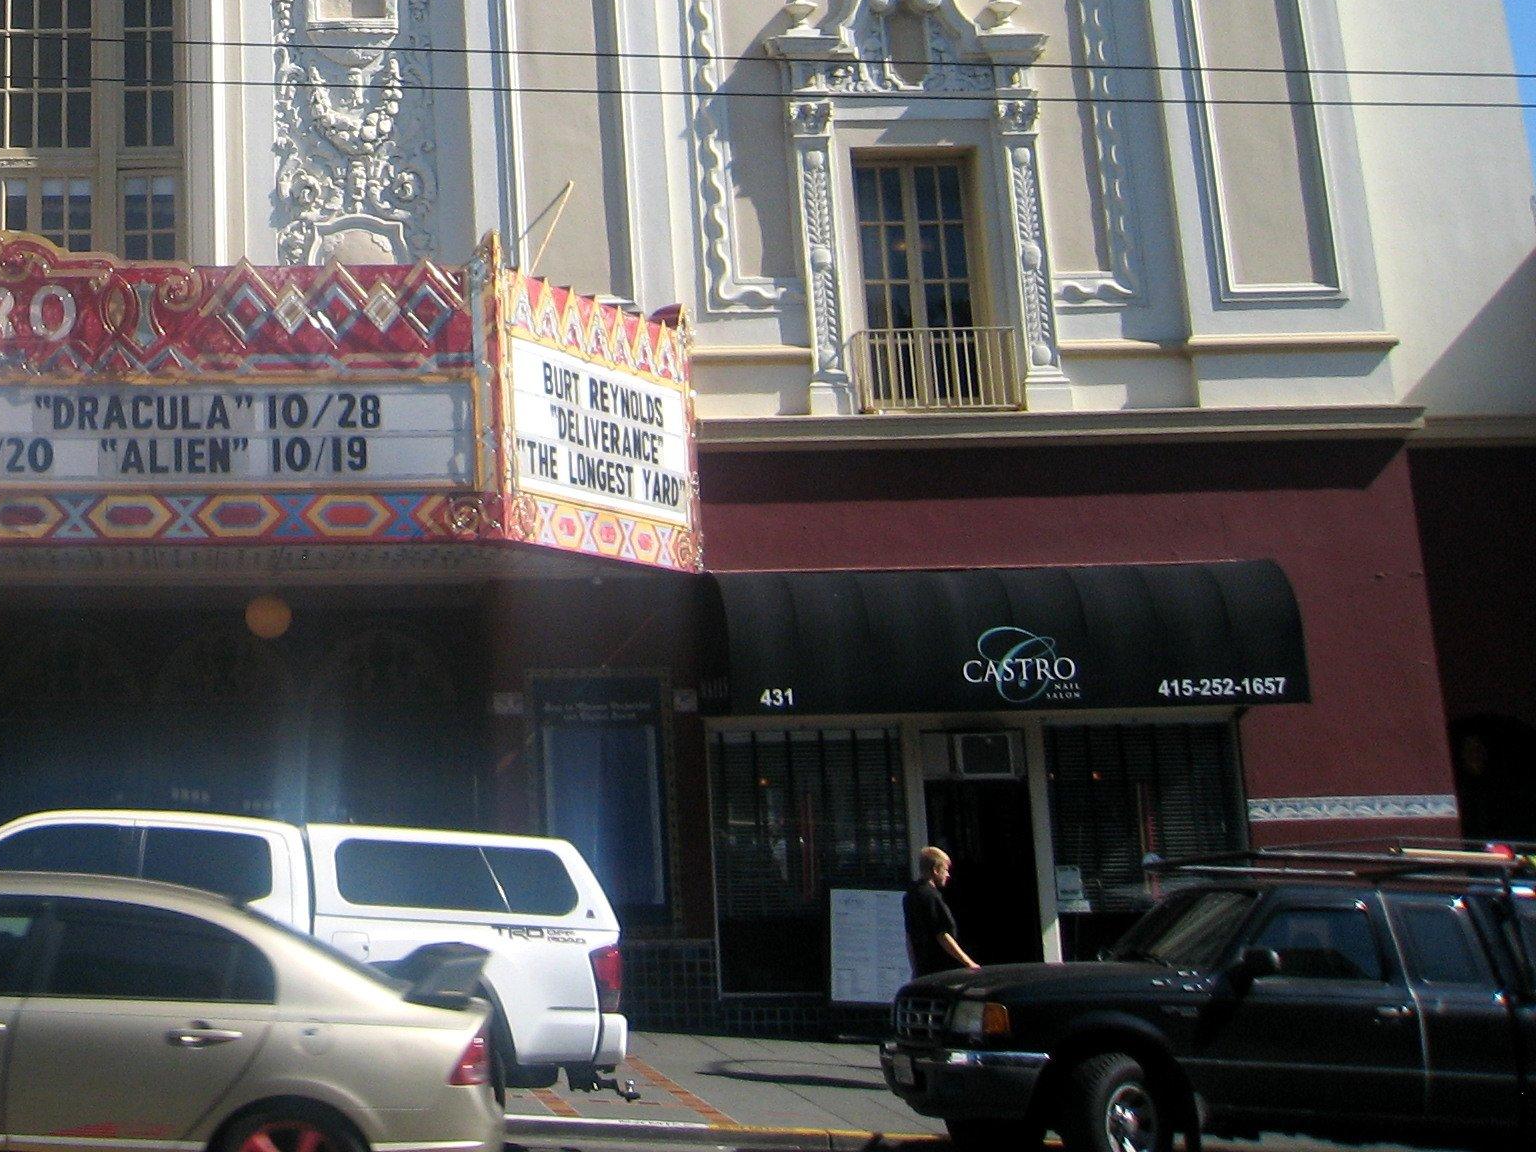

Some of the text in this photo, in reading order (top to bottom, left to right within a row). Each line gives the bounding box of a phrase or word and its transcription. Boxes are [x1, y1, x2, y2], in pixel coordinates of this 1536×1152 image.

[542, 360, 664, 428] BURT REYNOLDS
[35, 395, 253, 431] "DRACULA"
[267, 393, 381, 430] 10/28
[551, 404, 664, 465] "DELIVERANCE"
[100, 438, 249, 474] "ALIEN"
[271, 436, 368, 473] 10/19
[516, 437, 685, 507] "THE LONGEST YARD"
[963, 656, 1076, 683] CASTRO
[759, 688, 795, 707] 431
[1157, 676, 1287, 699] 415-252-1657
[491, 924, 544, 940] TRD
[547, 936, 586, 944] ROAD
